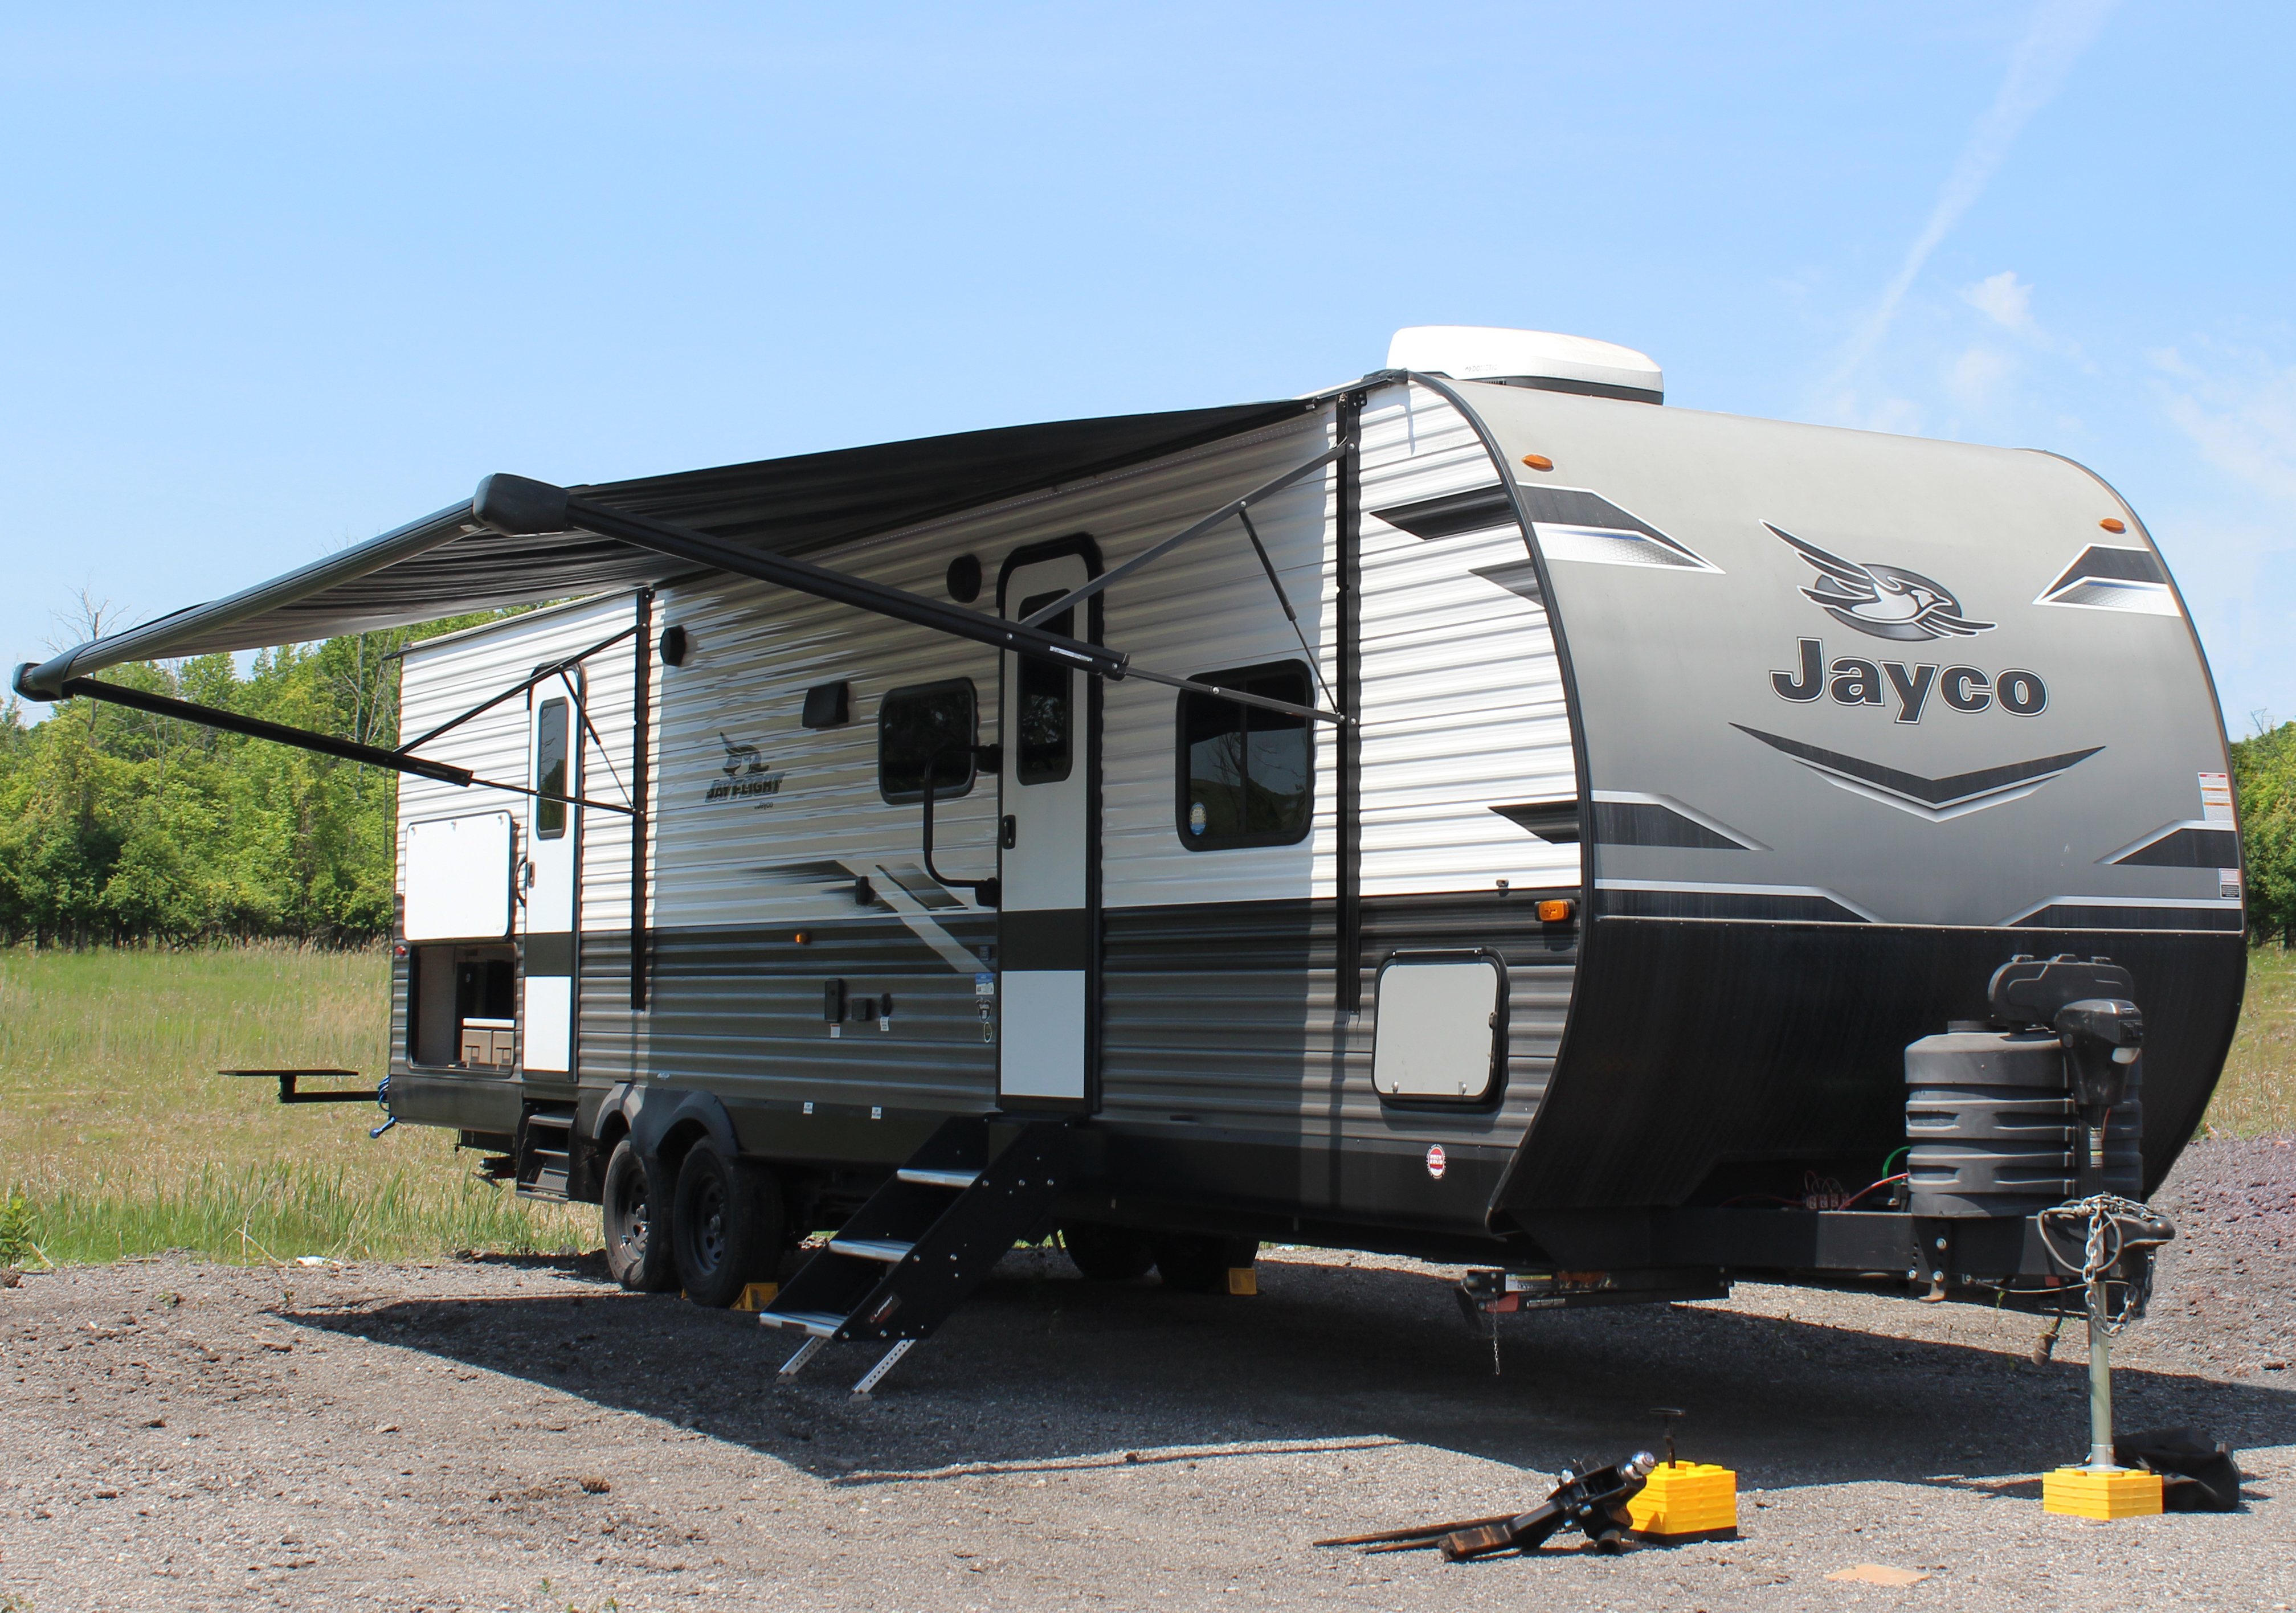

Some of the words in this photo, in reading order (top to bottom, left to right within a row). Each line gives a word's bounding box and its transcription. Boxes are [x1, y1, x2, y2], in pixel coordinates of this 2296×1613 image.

[1769, 636, 2048, 724] Jayco
[705, 779, 733, 803] JAY
[730, 772, 785, 799] FLIGHT
